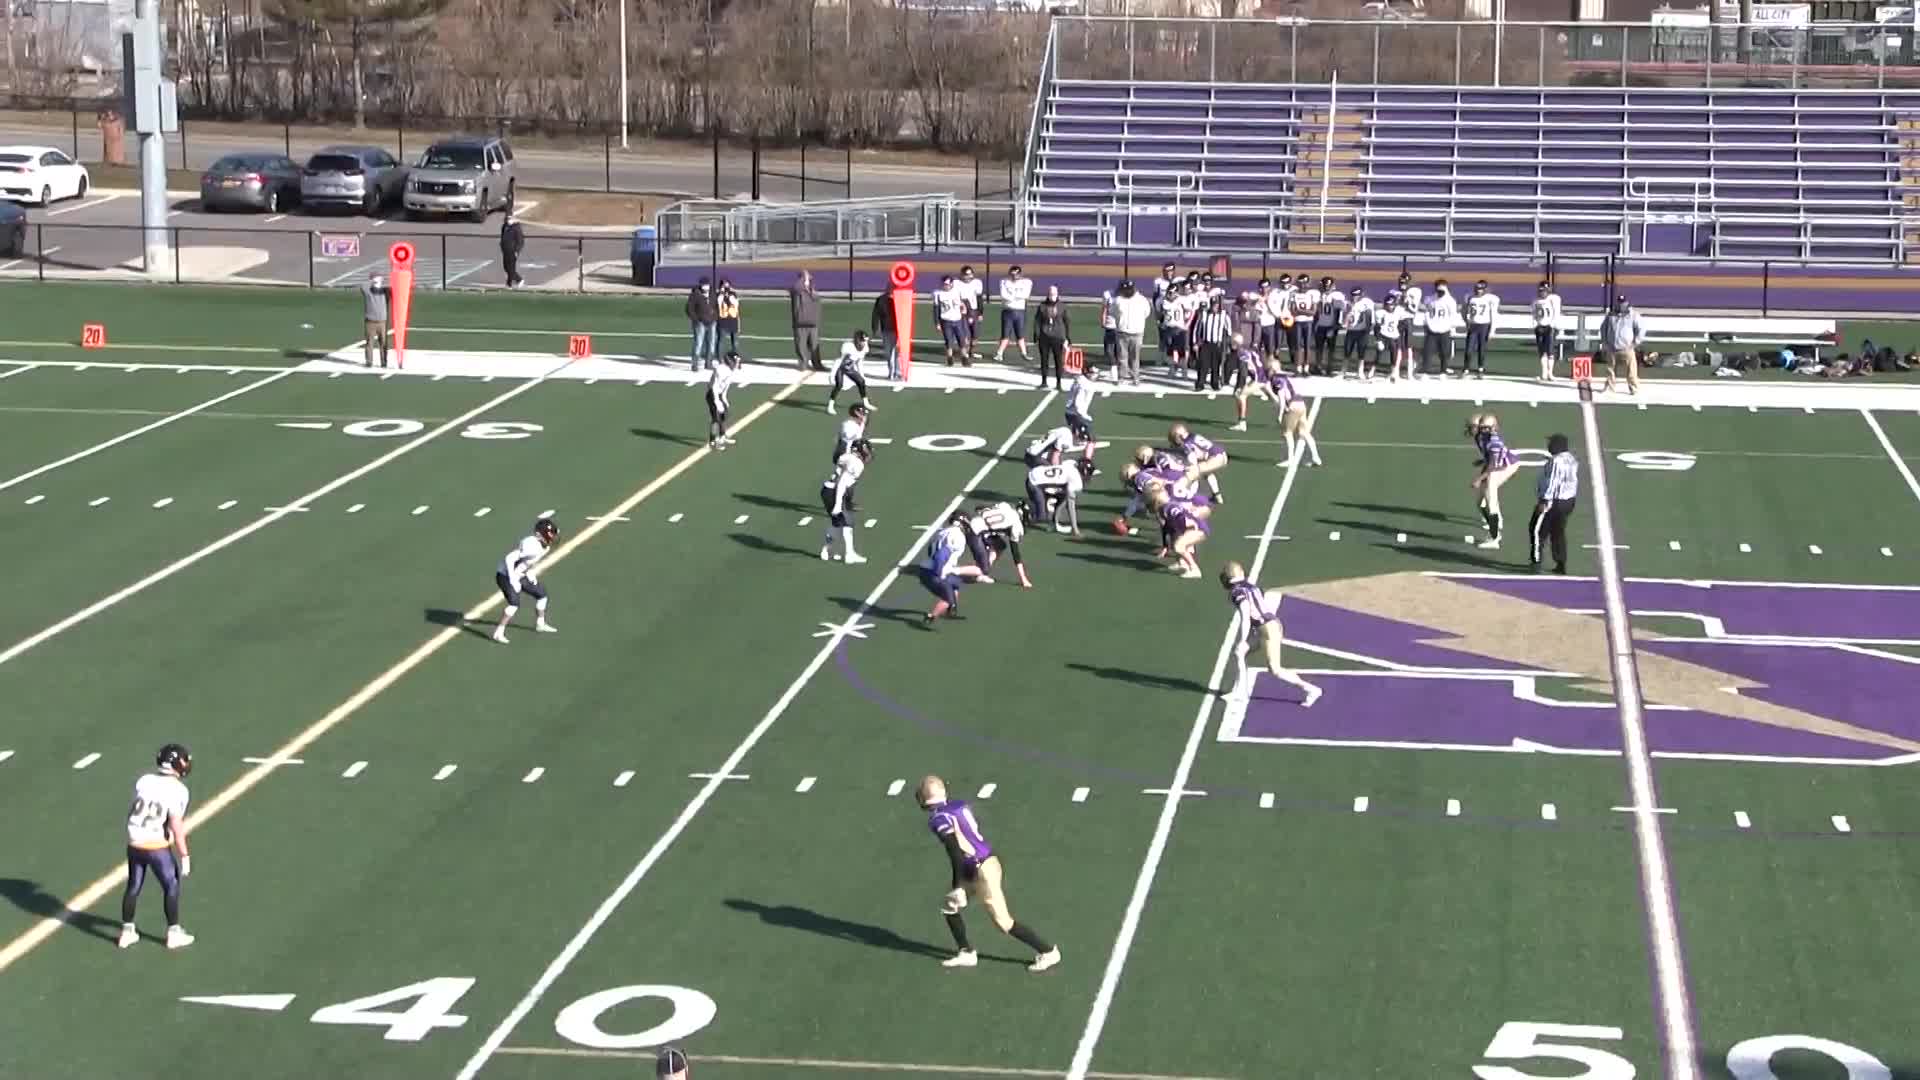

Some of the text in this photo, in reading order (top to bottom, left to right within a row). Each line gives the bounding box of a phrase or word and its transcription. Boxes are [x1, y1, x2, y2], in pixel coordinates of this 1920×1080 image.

[86, 327, 100, 344] 20
[571, 339, 586, 356] 30
[1066, 351, 1081, 368] 40
[1575, 360, 1590, 377] 50
[310, 976, 718, 1048] 40
